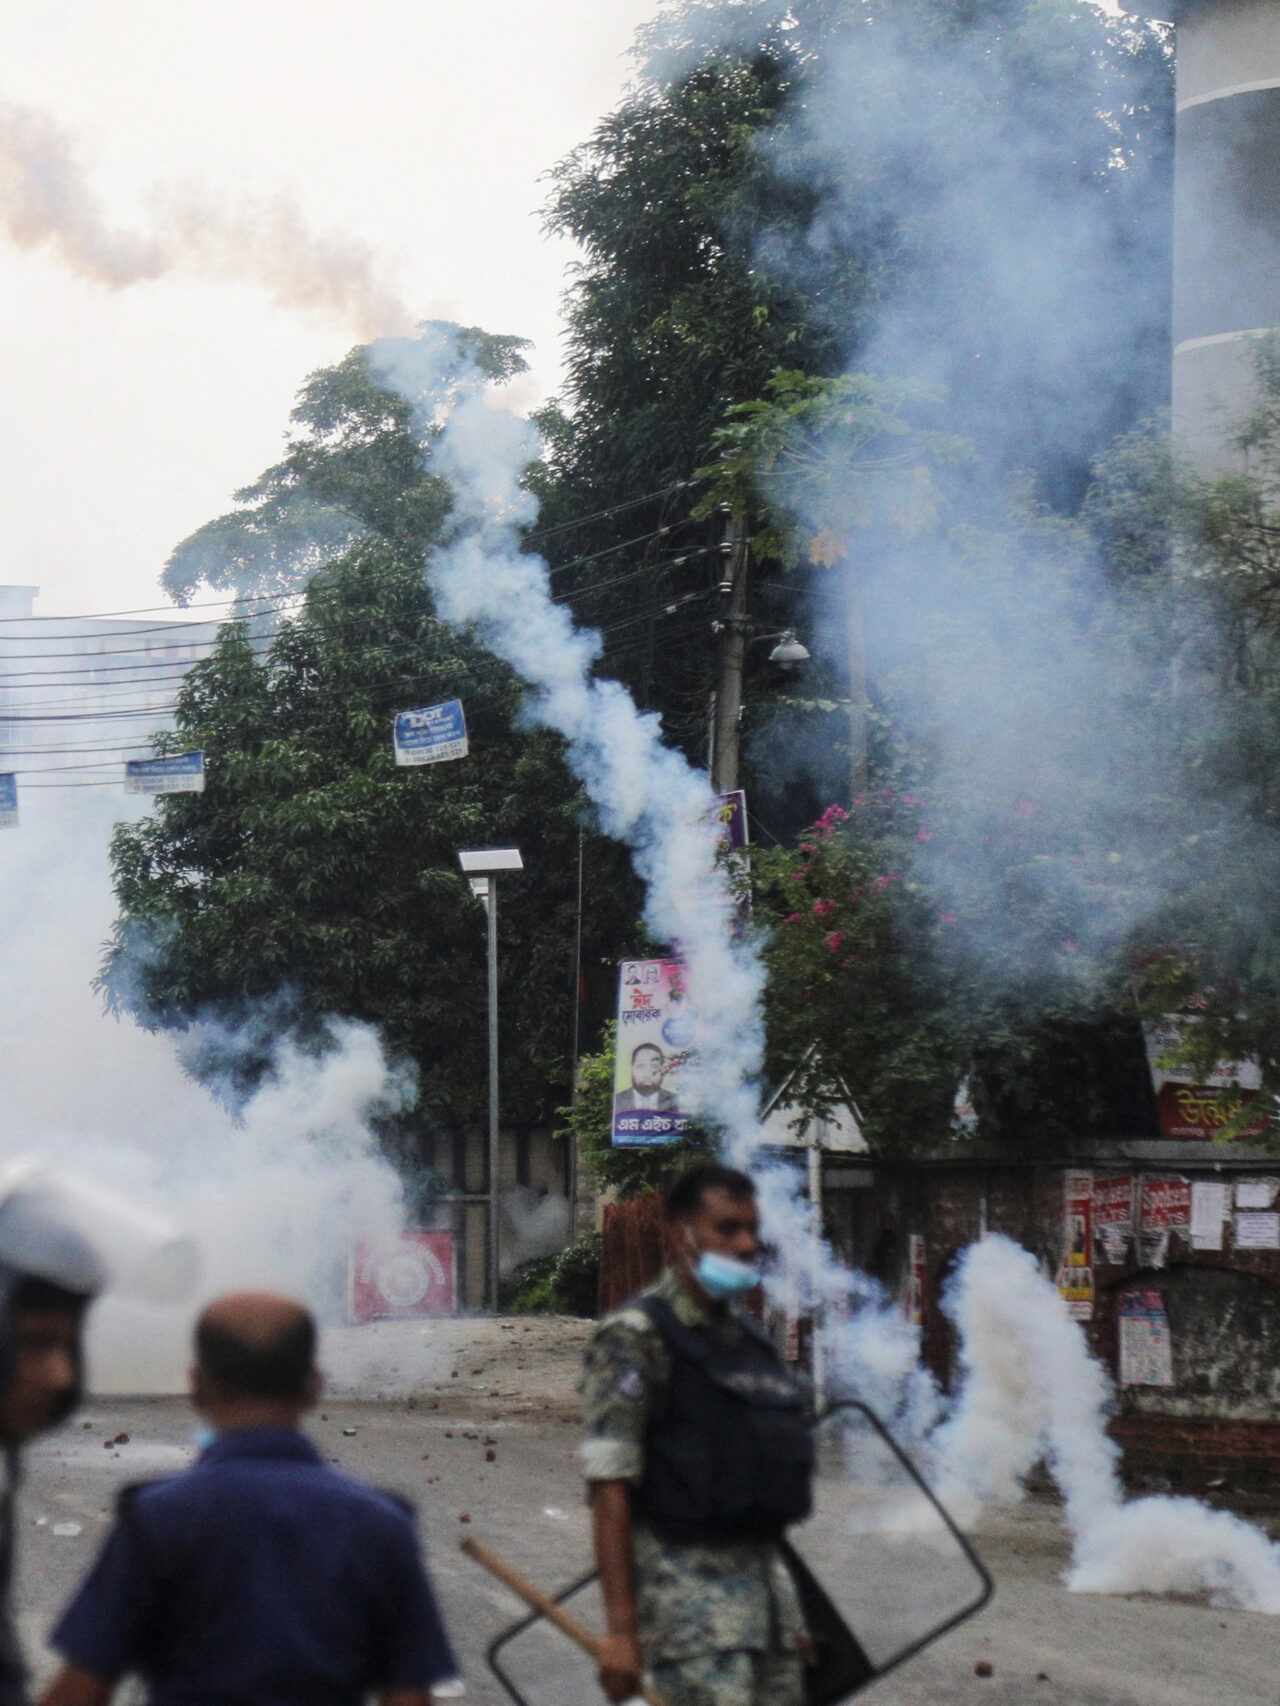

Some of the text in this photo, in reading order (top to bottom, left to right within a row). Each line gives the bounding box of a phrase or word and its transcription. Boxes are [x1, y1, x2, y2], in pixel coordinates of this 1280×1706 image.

[630, 988, 653, 1009] ঈদ
[622, 1008, 662, 1025] মোবারক
[617, 1118, 639, 1131] এম
[642, 1115, 673, 1131] এইচ
